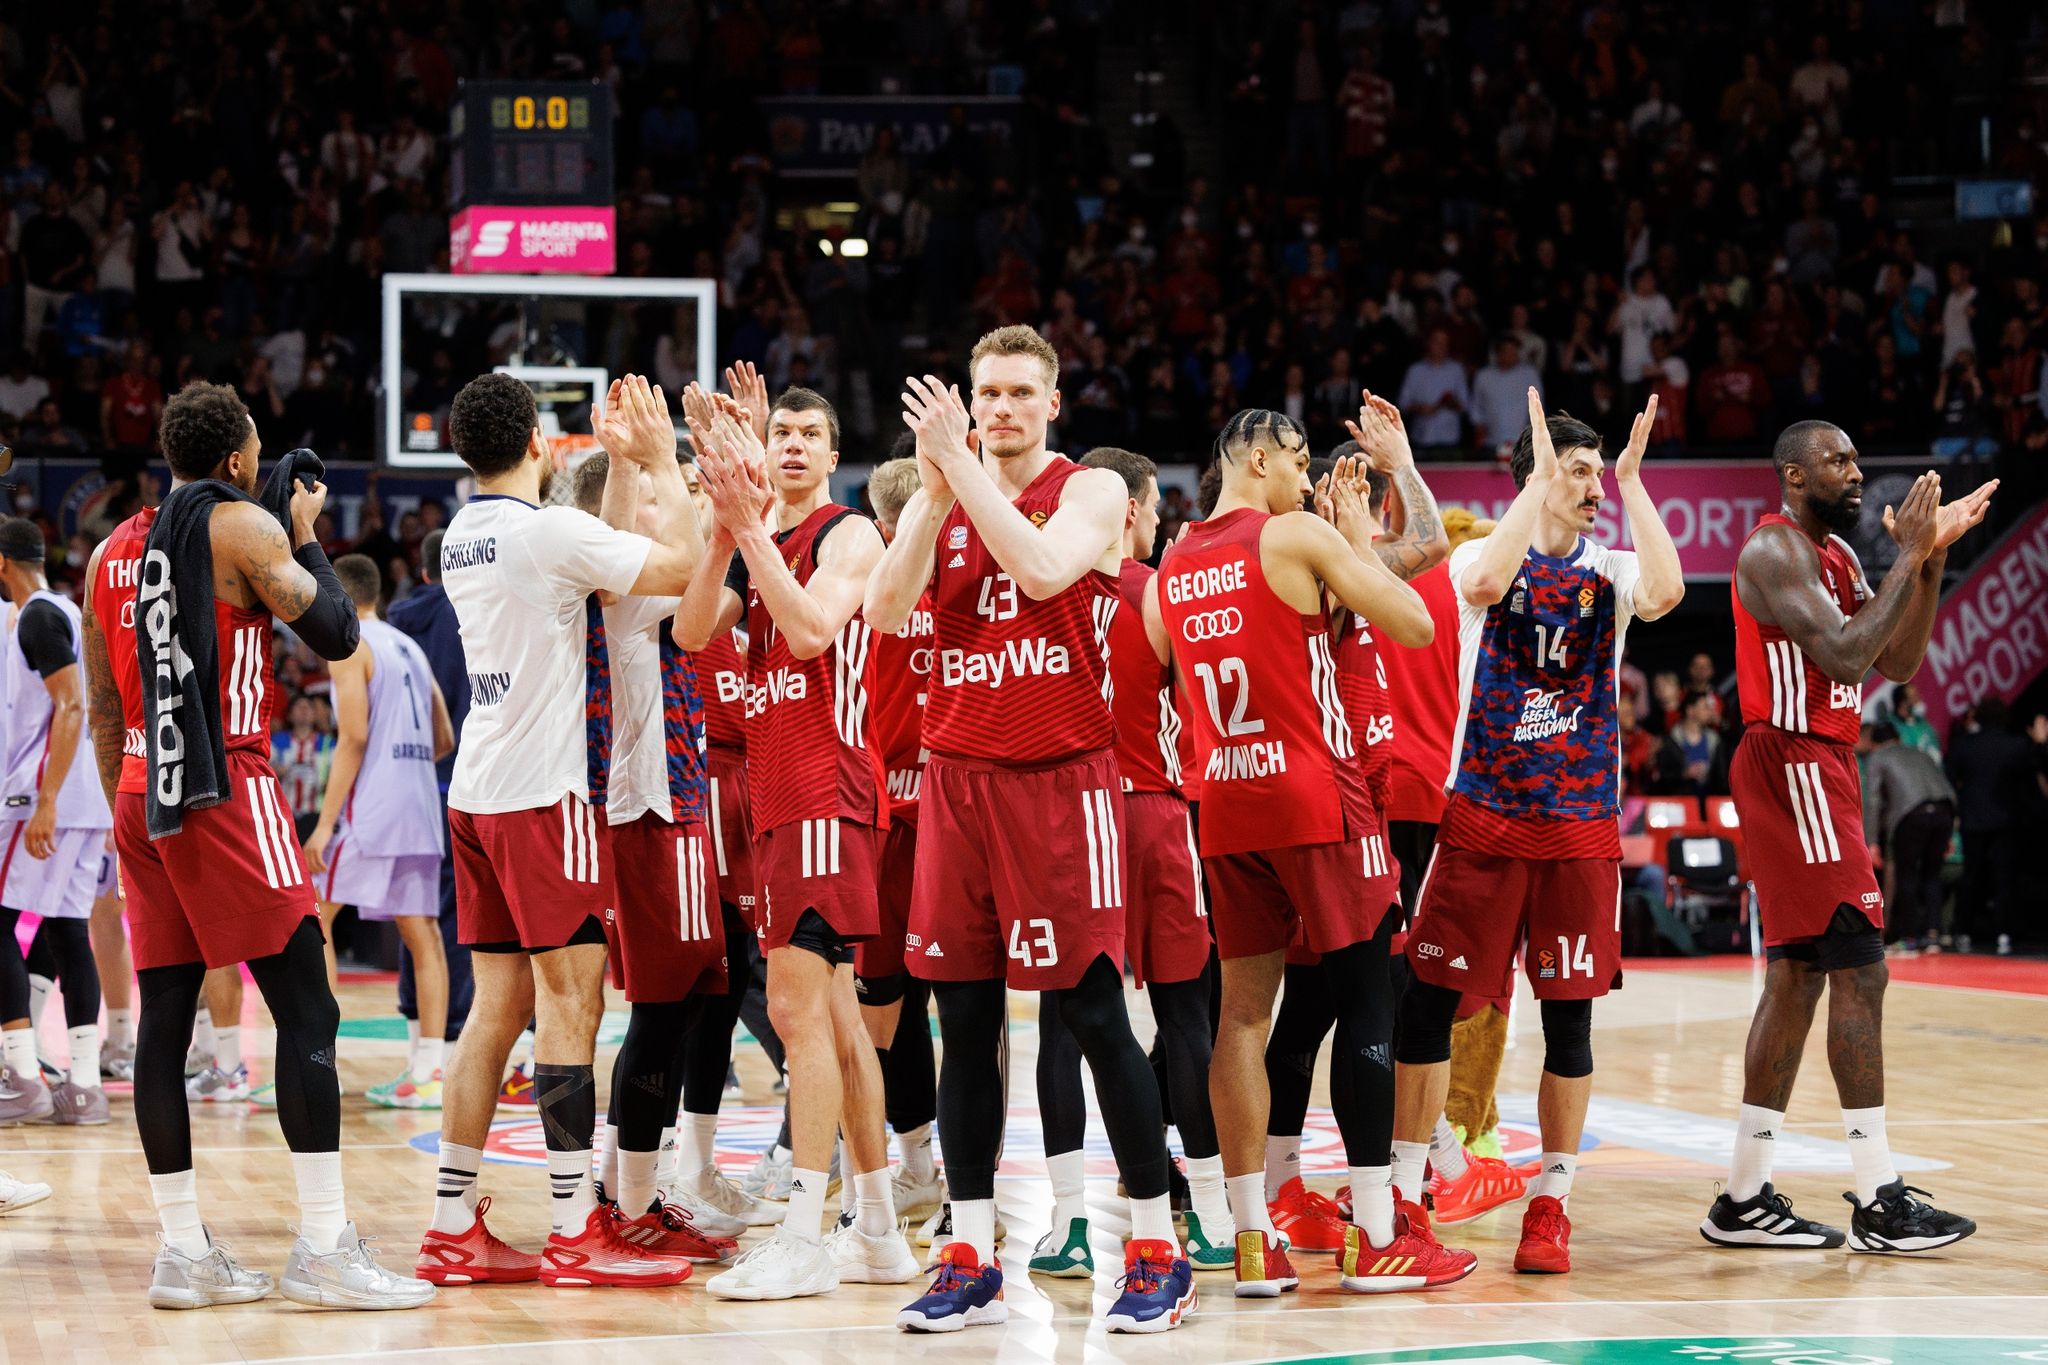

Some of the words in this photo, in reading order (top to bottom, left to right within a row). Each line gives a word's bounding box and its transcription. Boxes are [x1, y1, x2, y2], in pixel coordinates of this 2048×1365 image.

[520, 221, 608, 240] MAGENTA
[520, 239, 578, 258] SPORT
[977, 572, 1018, 623] 43
[1167, 559, 1247, 605] GEORGE
[1927, 515, 2048, 686] MAGEN
[941, 637, 1070, 689] BayWa
[1535, 624, 1568, 669] 14
[140, 549, 194, 807] adidas
[745, 666, 807, 719] BaWa
[1194, 656, 1265, 738] 12
[1513, 705, 1583, 742] RASSISMUS
[1520, 701, 1560, 724] GEGEN
[1204, 740, 1287, 782] MUNICH
[1009, 918, 1058, 967] 43
[1557, 934, 1594, 979] 14
